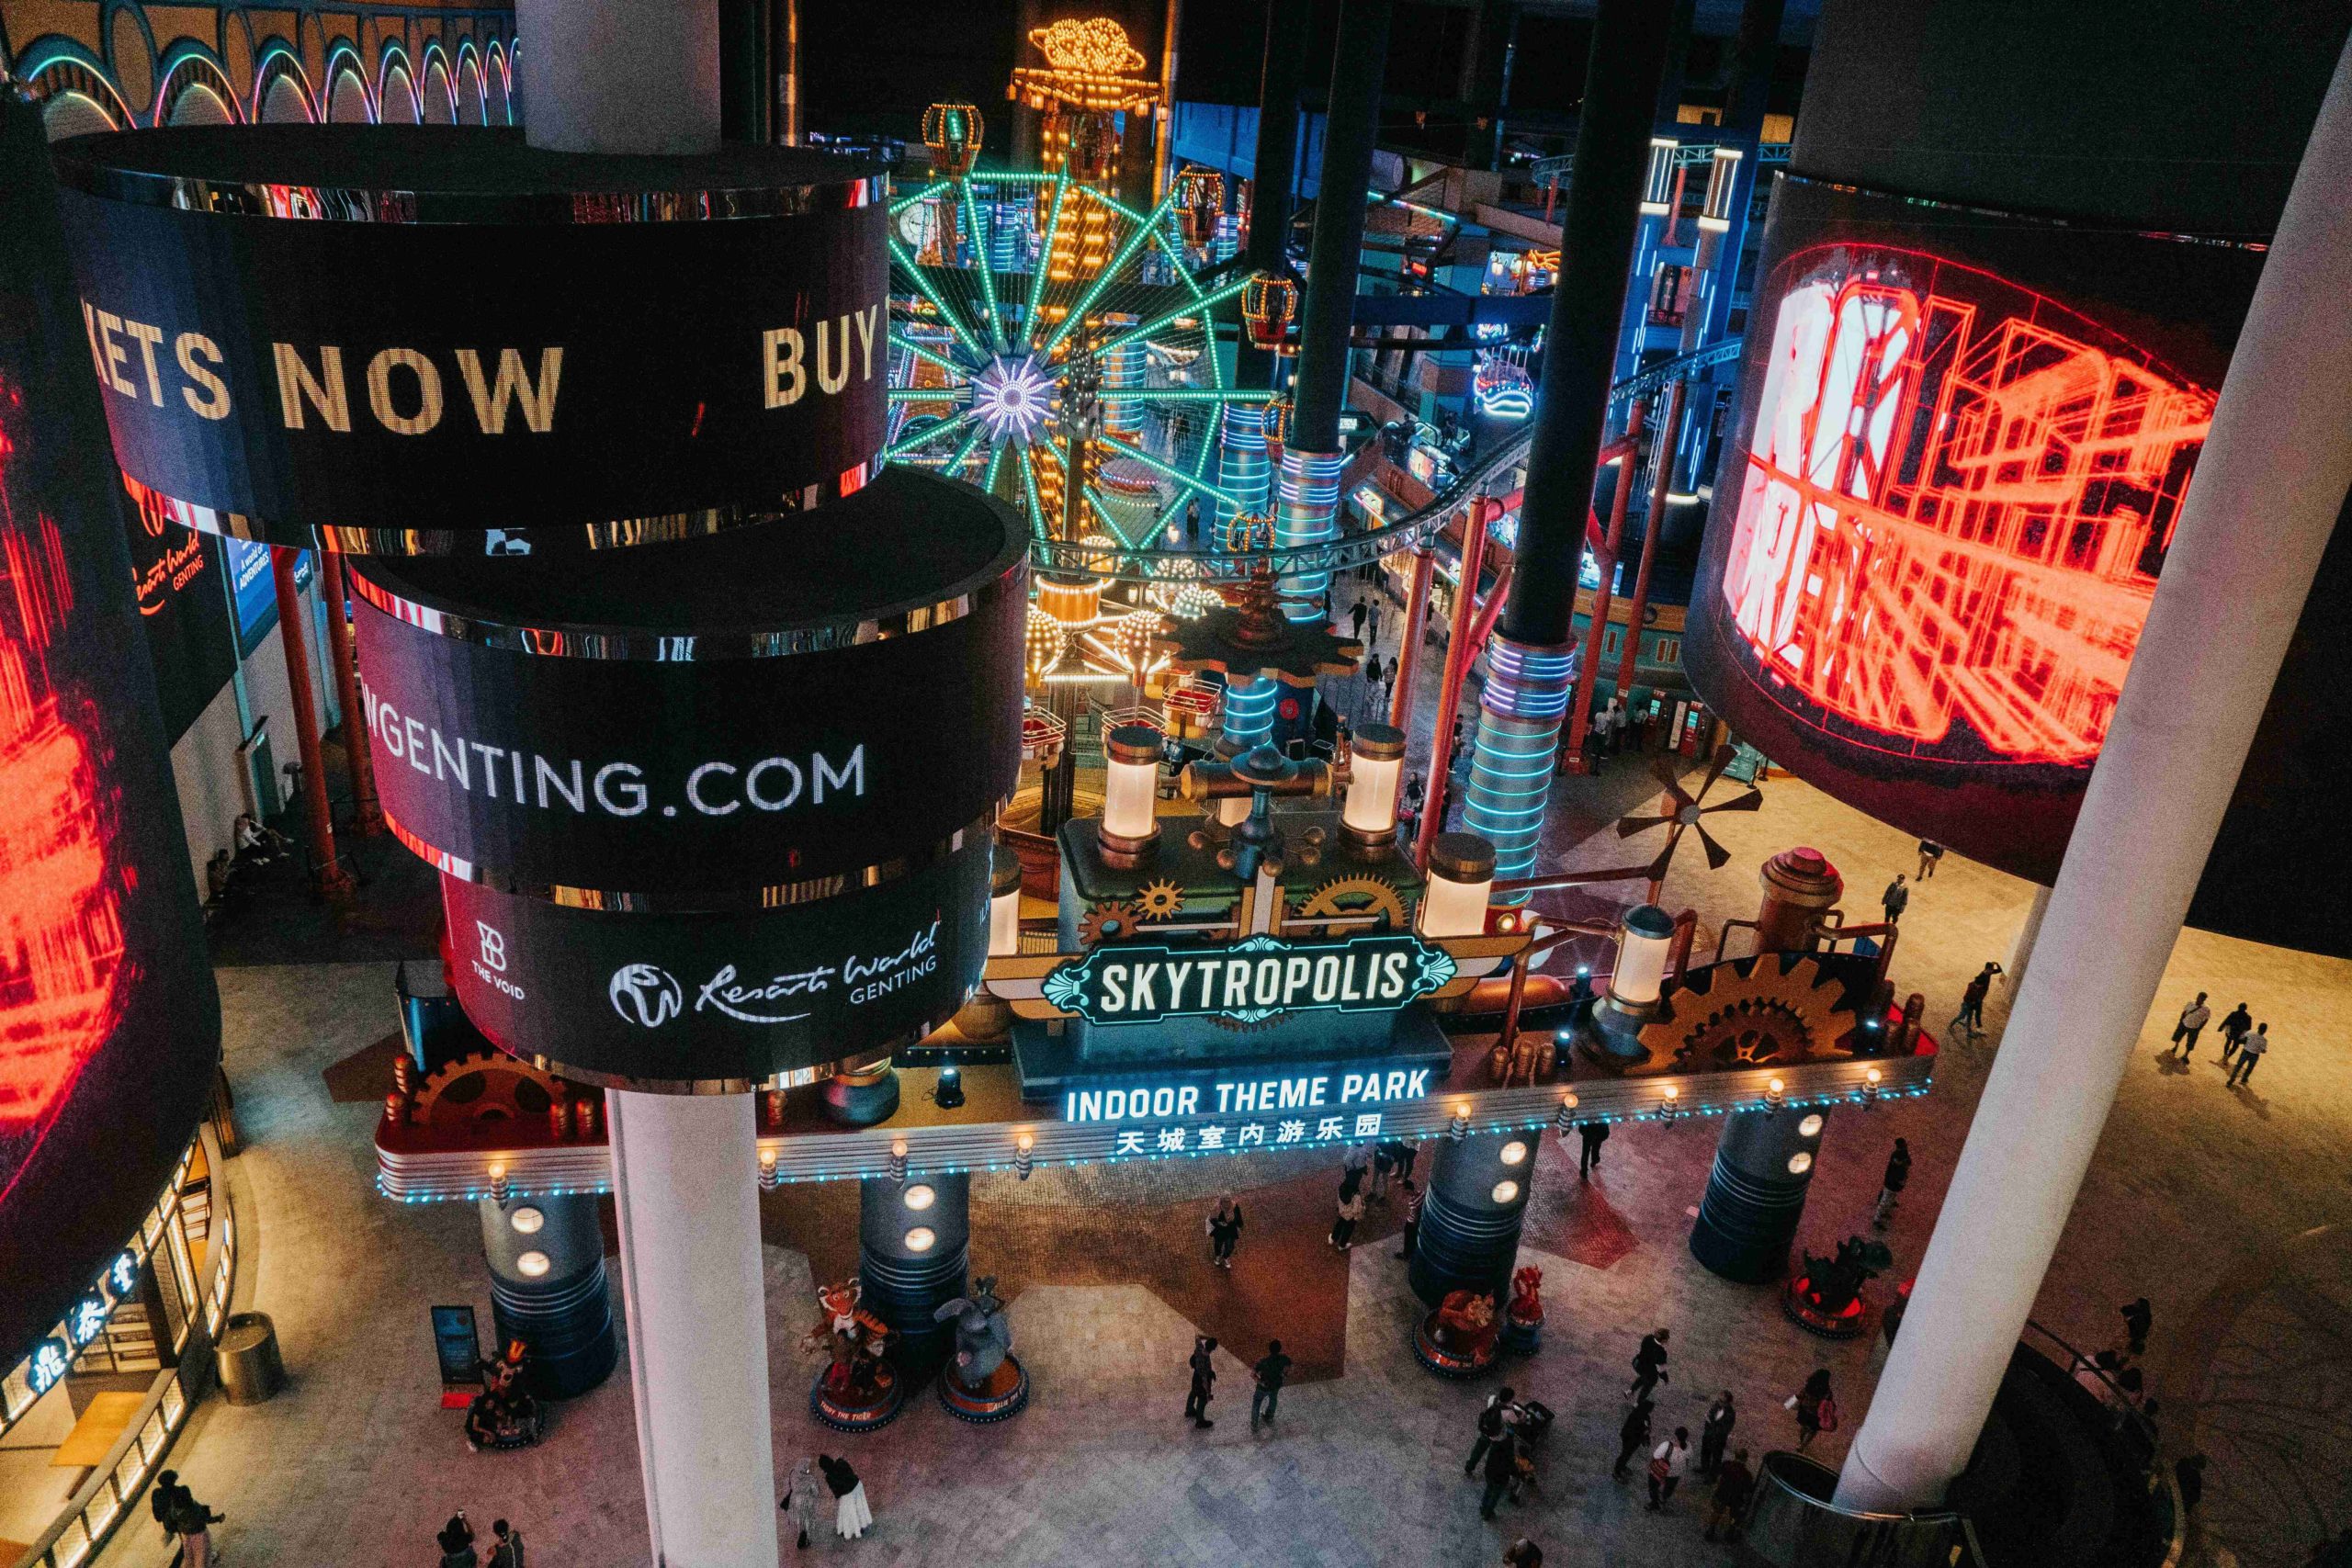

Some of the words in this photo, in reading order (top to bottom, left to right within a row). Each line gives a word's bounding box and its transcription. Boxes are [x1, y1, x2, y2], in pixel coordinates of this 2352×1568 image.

[273, 343, 563, 435] NOW
[763, 304, 878, 410] BUY
[173, 554, 204, 591] GENTING
[240, 551, 269, 591] ADVENTURES
[471, 959, 492, 984] THE
[493, 975, 526, 1000] VOID
[695, 964, 836, 1023] Resorts
[844, 920, 941, 984] World
[850, 955, 937, 1006] GENTING
[1101, 953, 1408, 1011] SKYTROPOLIS
[1067, 1088, 1198, 1122] INDOOR
[1216, 1077, 1328, 1112] THEME
[1340, 1069, 1430, 1103] PARK
[1115, 1113, 1383, 1156] 天城室内游乐园
